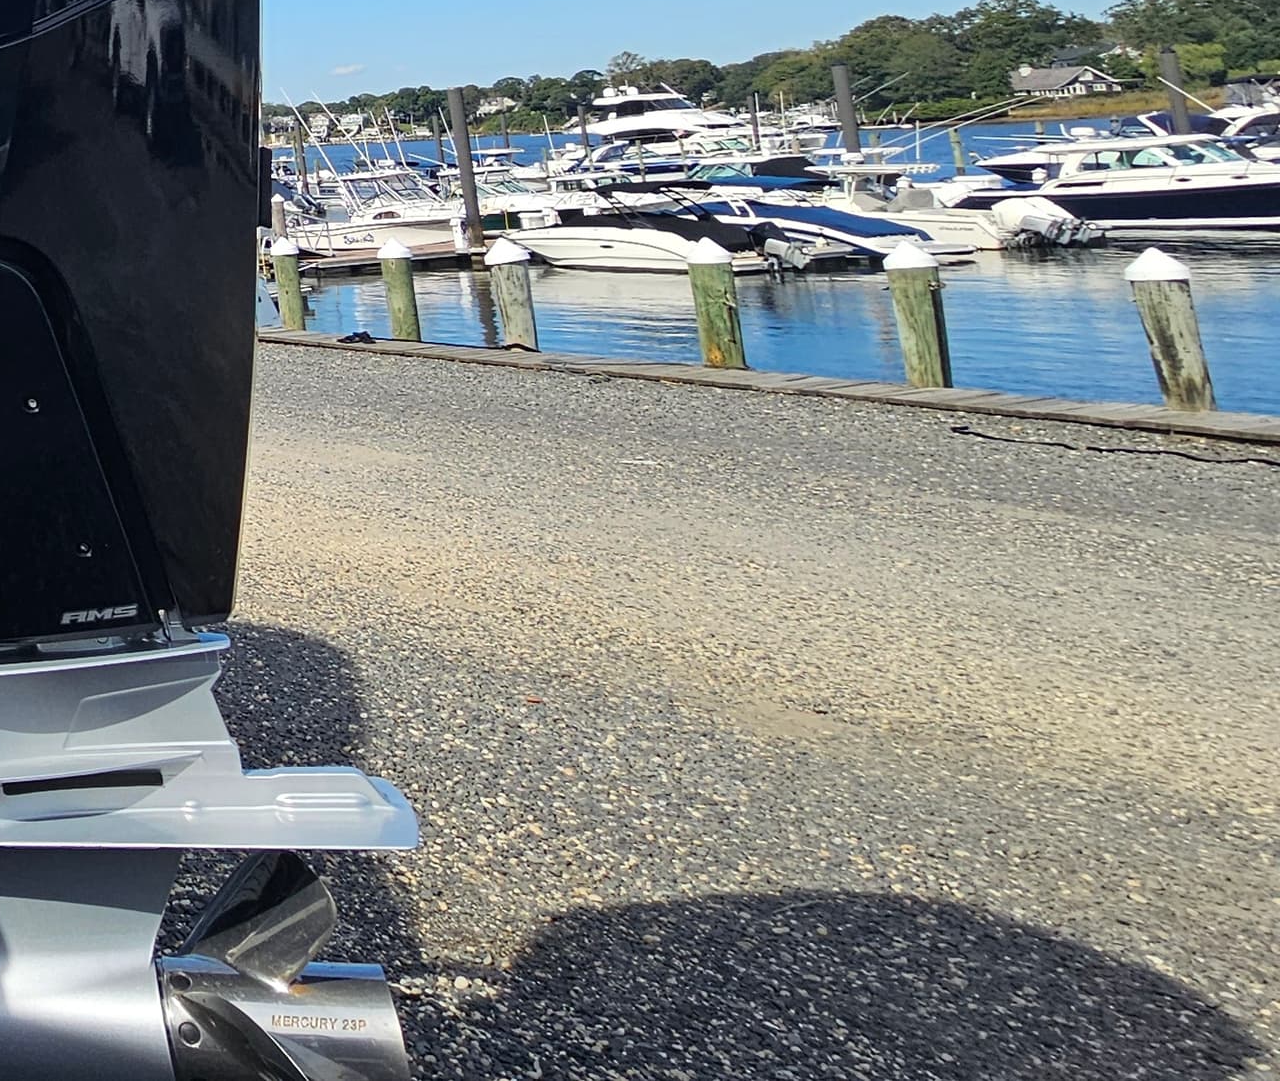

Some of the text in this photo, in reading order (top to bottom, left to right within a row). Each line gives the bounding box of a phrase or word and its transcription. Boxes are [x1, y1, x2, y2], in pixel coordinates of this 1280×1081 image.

[60, 604, 138, 625] AMS
[271, 1014, 367, 1031] MERCURY 23P
